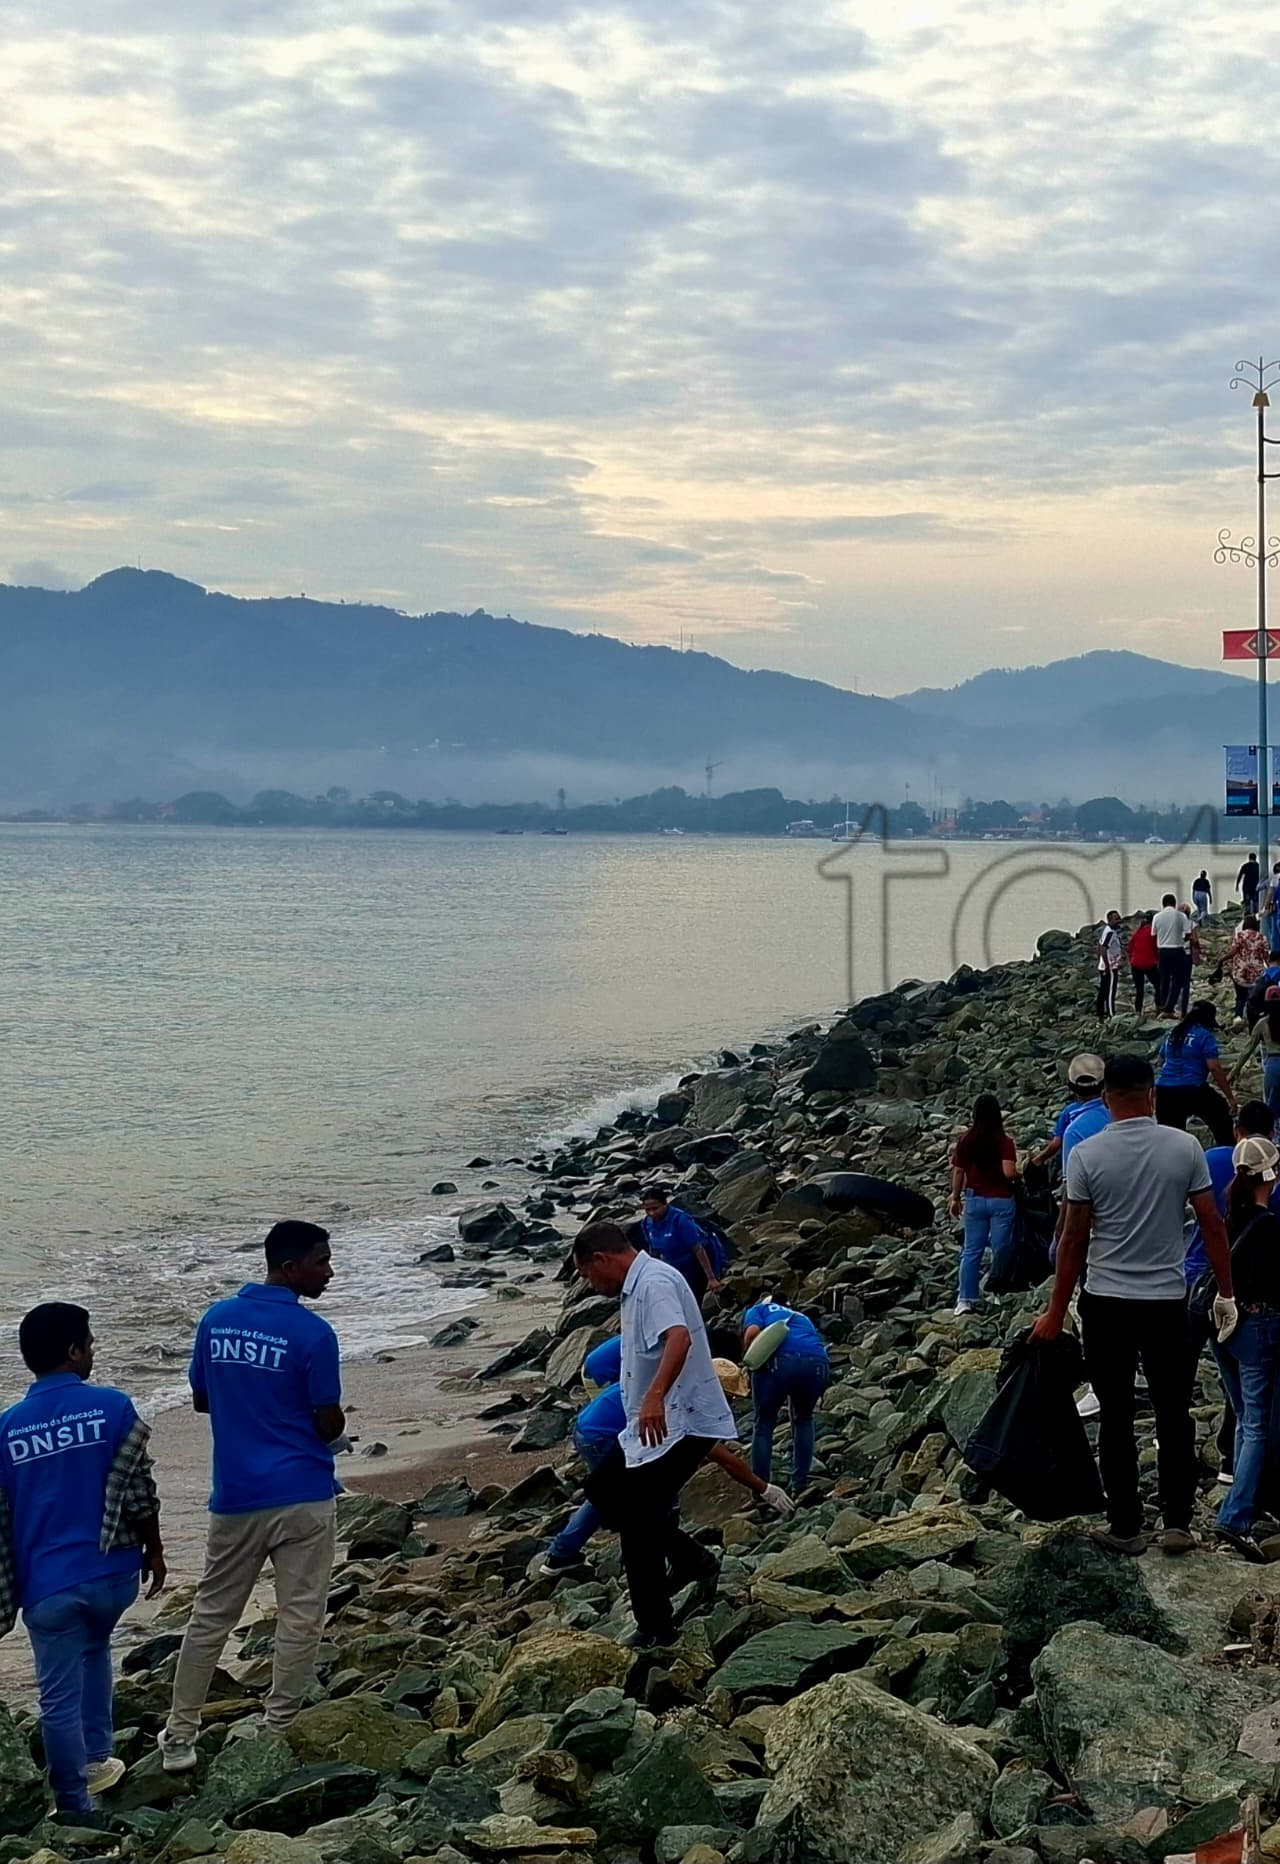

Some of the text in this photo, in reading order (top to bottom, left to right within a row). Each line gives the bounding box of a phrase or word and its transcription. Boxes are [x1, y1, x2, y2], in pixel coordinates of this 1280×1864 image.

[210, 1338, 287, 1368] DNSIT
[252, 1331, 288, 1346] Educação
[7, 1421, 48, 1438] Ministério
[62, 1408, 104, 1424] Educação
[8, 1418, 106, 1461] DNSIT
